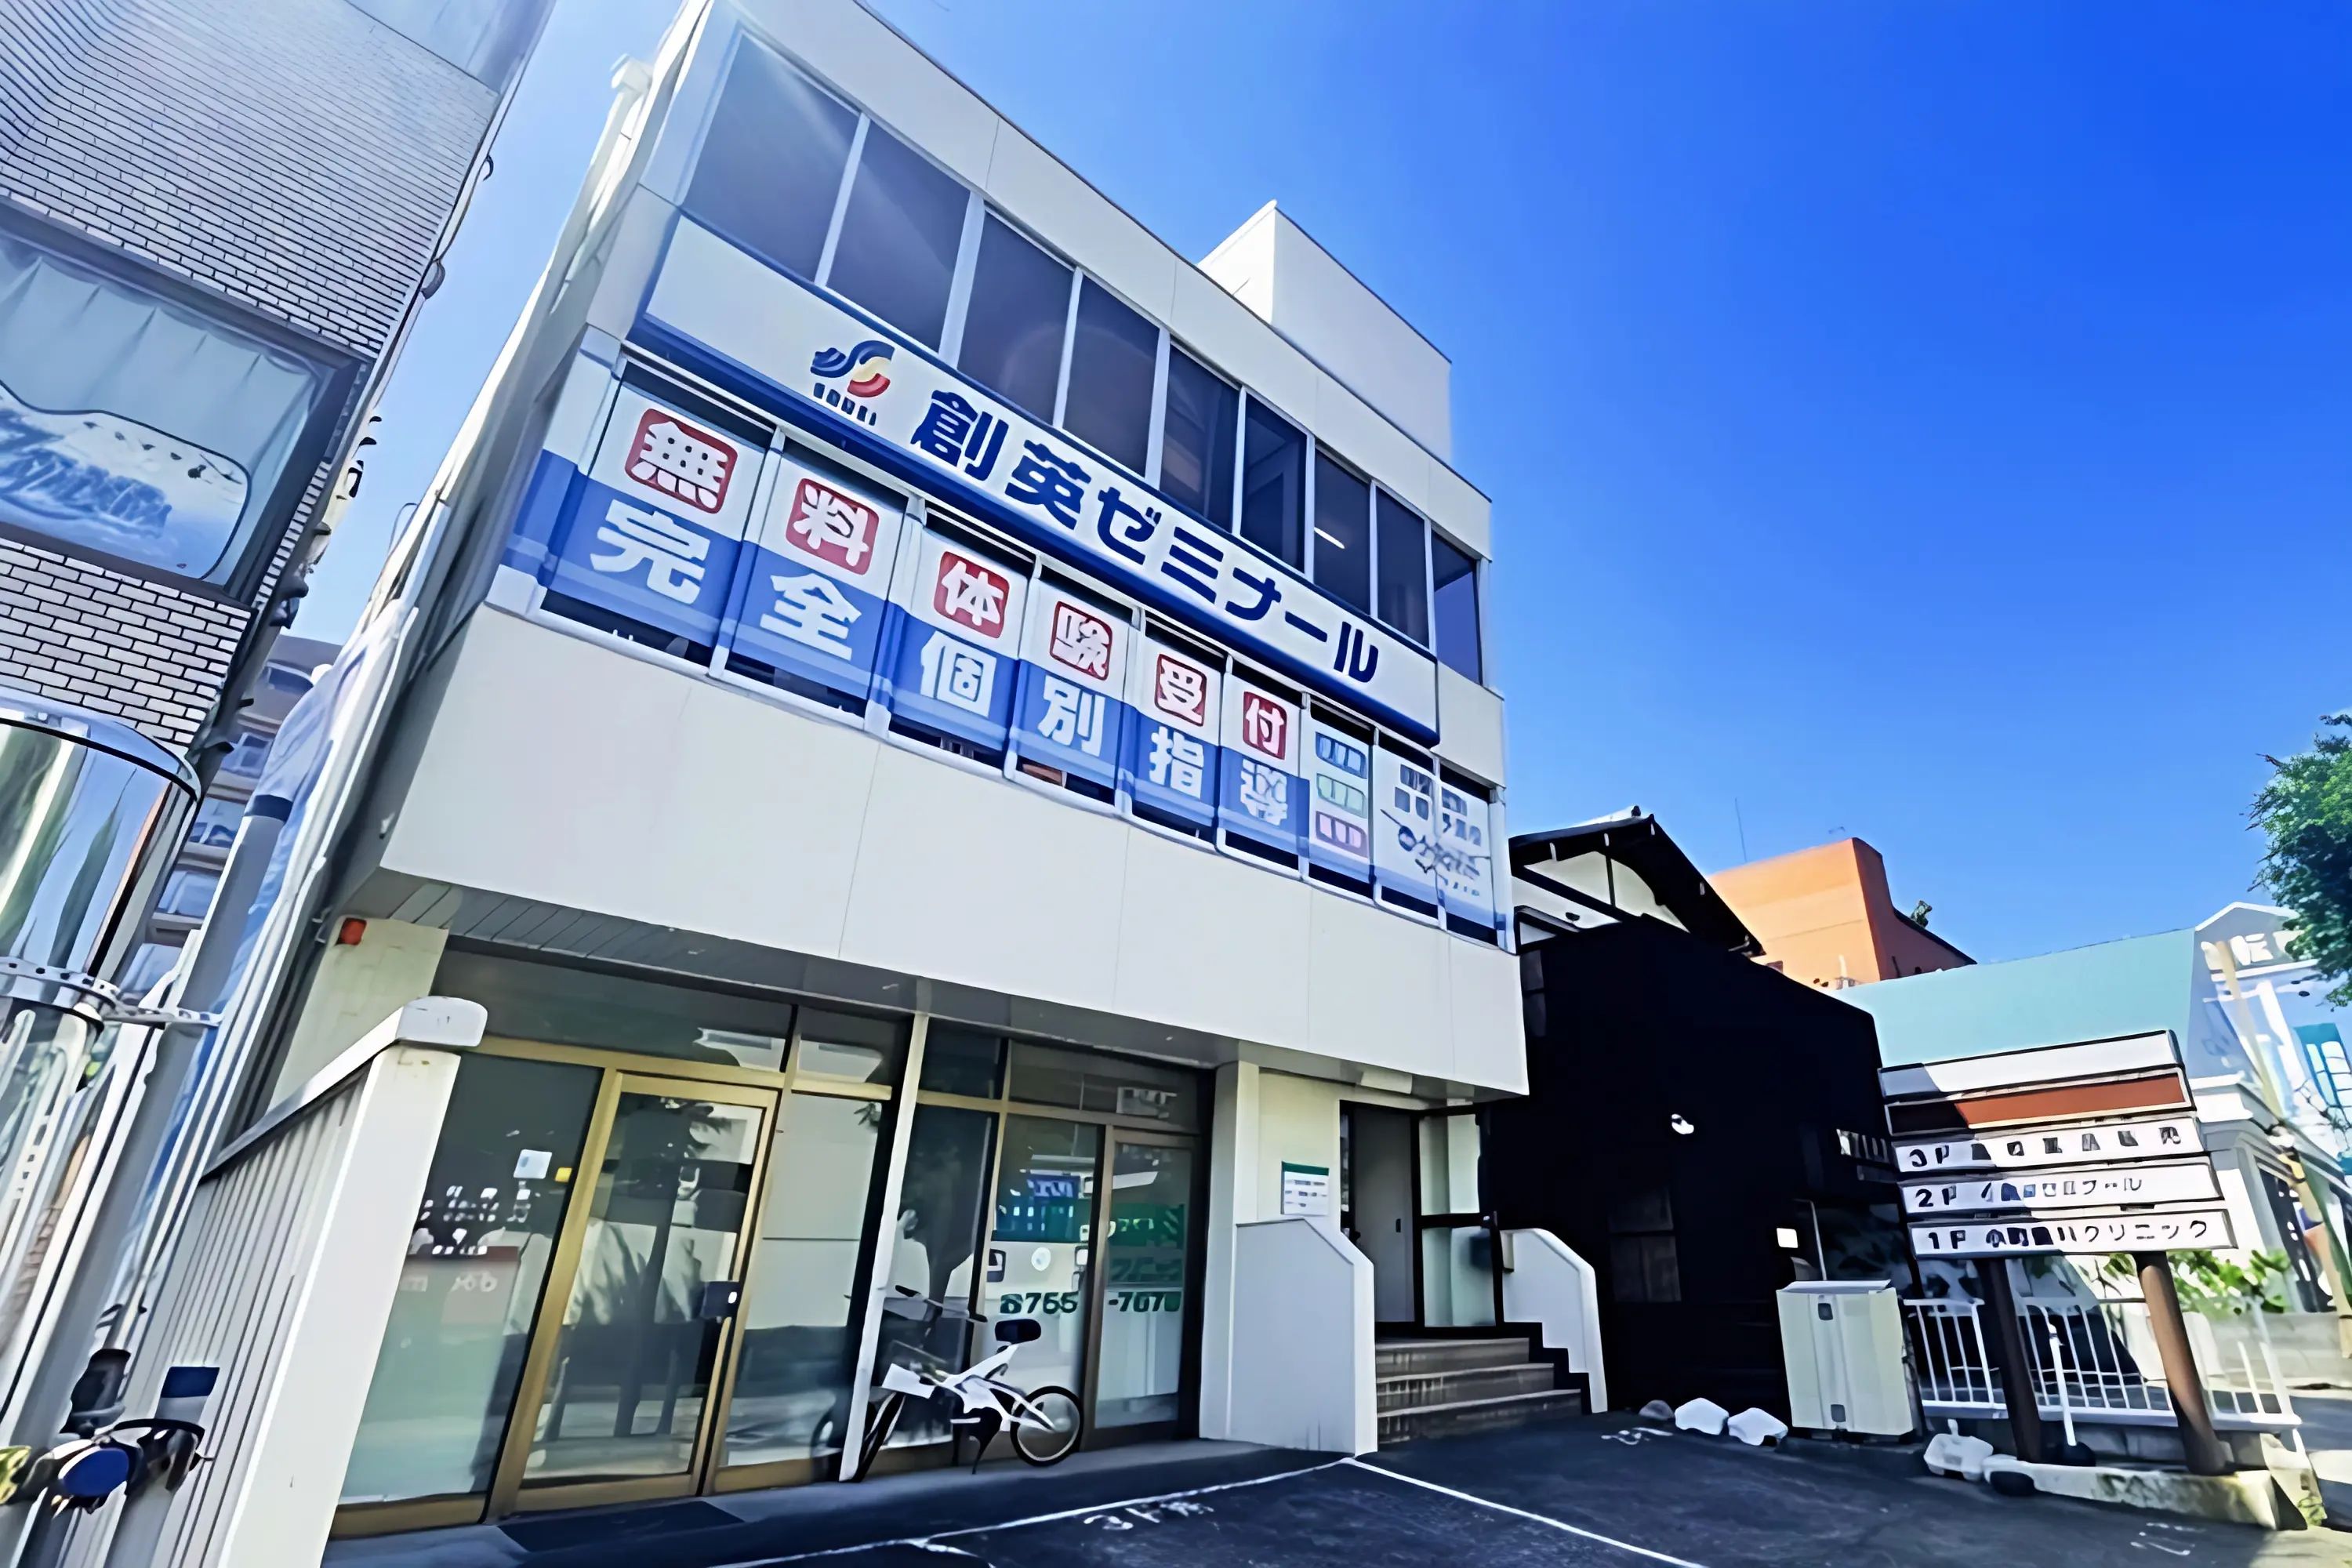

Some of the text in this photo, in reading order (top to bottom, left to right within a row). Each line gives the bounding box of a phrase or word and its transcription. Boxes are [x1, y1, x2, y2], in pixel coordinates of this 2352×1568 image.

[910, 390, 1379, 684] 創英ゼミナール
